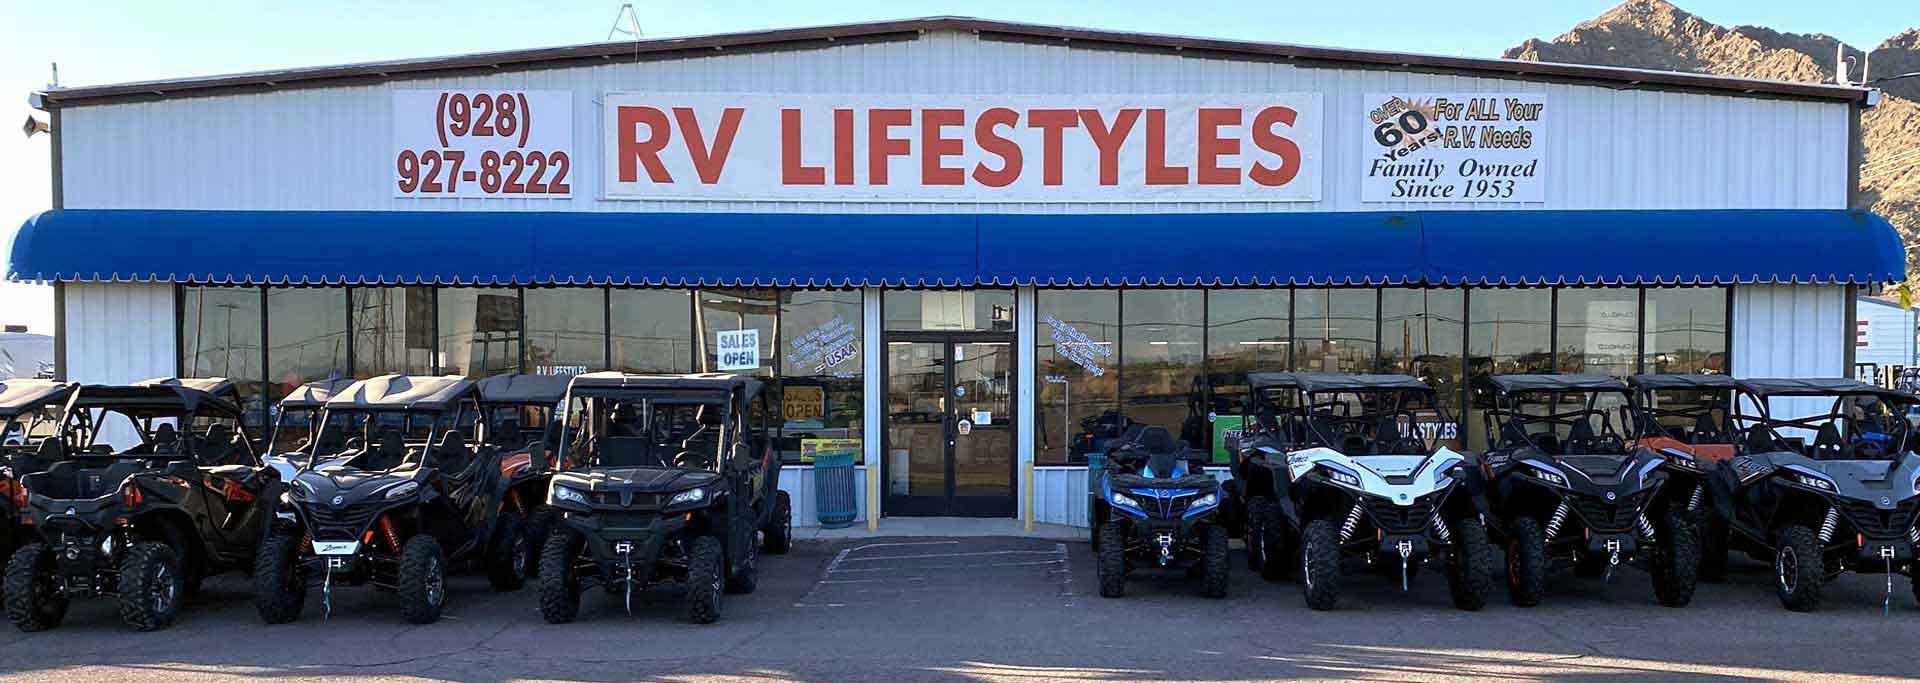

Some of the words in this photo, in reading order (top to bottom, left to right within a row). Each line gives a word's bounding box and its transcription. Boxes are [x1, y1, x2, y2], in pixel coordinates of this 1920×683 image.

[436, 93, 530, 148] (928)
[1370, 97, 1408, 124] OVER
[1434, 98, 1464, 121] For
[1465, 98, 1500, 121] ALL
[1504, 98, 1543, 121] Your
[1374, 110, 1428, 147] 60
[1443, 126, 1476, 149] R.V.
[1479, 126, 1532, 149] Needs
[617, 105, 745, 185] RV
[781, 105, 1302, 188] LIFESTYLES
[397, 150, 570, 194] 927-8222
[1369, 158, 1445, 181] Family
[1458, 158, 1539, 177] Owned
[1391, 179, 1455, 198] Since
[1463, 179, 1516, 198] 1953
[720, 334, 756, 349] SALES
[724, 351, 754, 366] OPEN
[825, 344, 857, 367] USAA
[786, 404, 822, 418] OPEN
